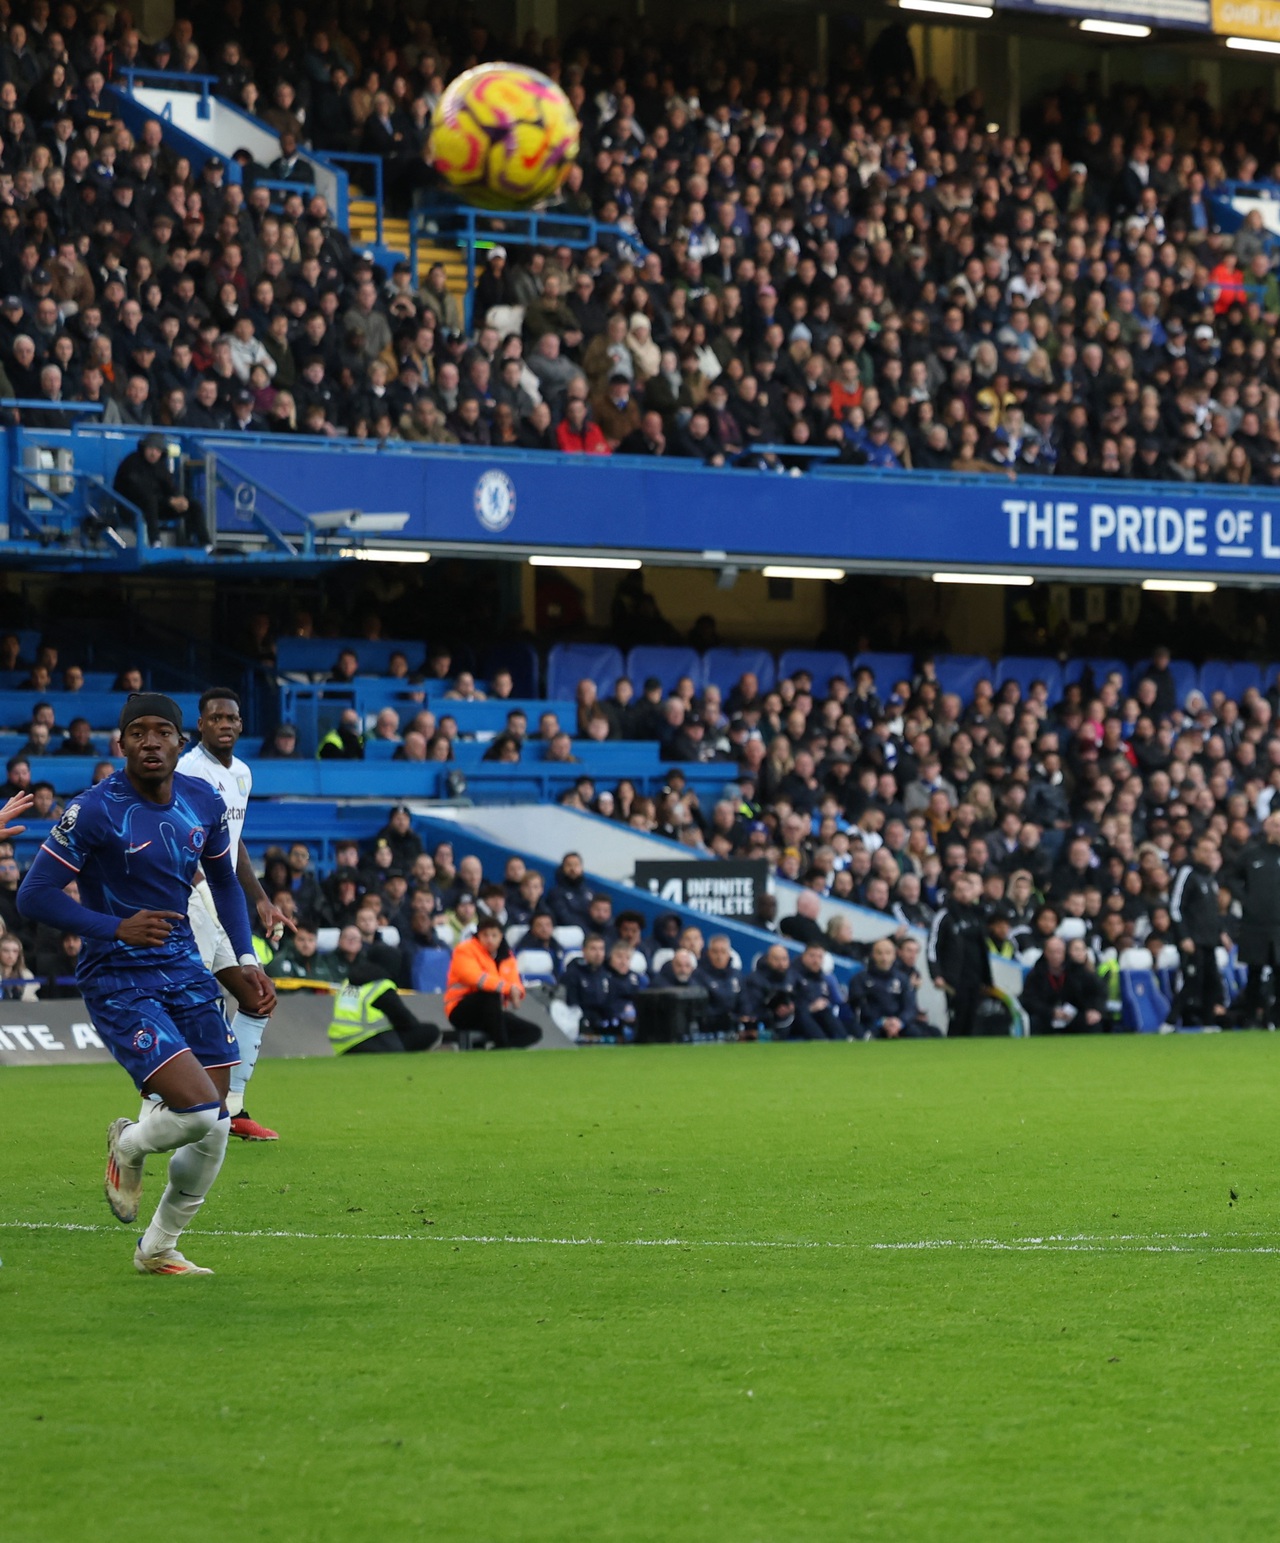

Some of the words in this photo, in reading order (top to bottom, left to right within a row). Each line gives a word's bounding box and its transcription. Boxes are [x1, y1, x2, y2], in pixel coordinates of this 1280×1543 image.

[1002, 500, 1079, 550] THE
[1090, 503, 1208, 556] PRIDE
[1215, 511, 1254, 545] OF
[686, 877, 754, 897] INFINITE
[71, 1022, 105, 1050] A
